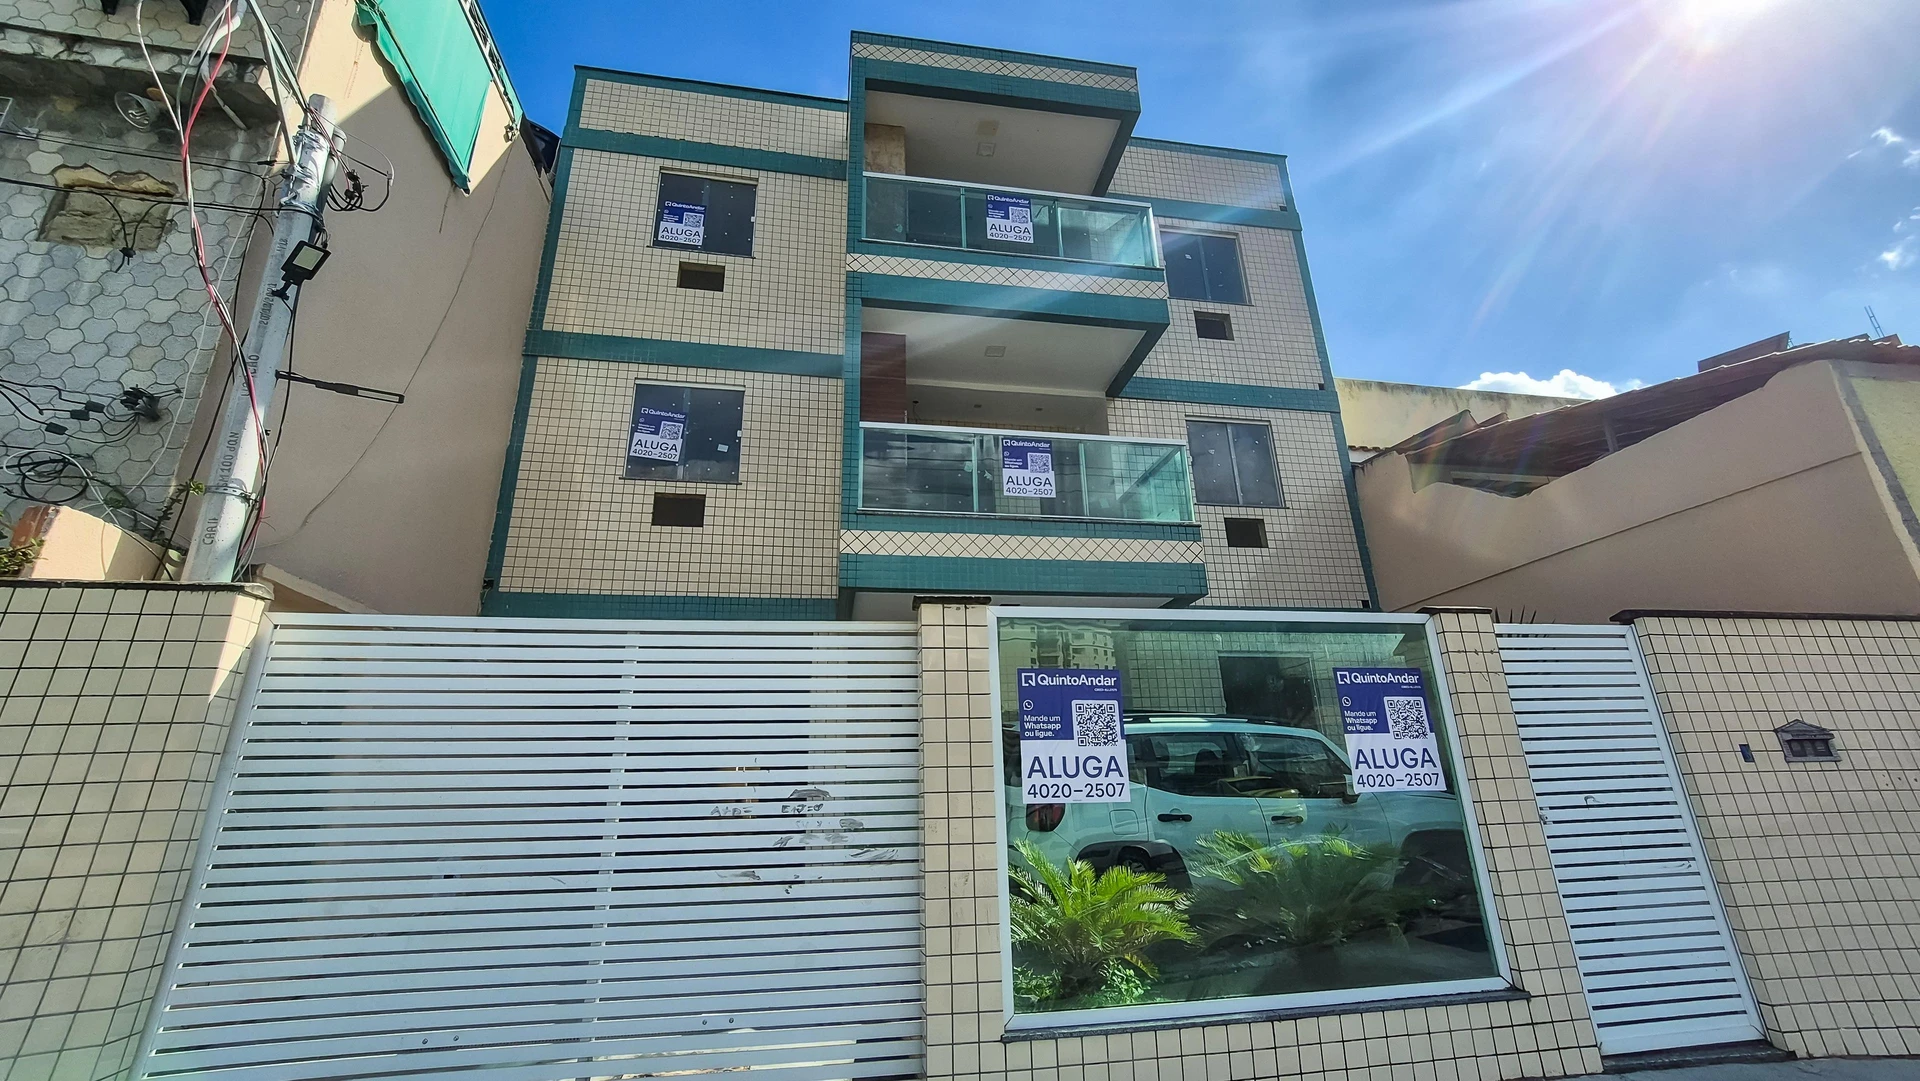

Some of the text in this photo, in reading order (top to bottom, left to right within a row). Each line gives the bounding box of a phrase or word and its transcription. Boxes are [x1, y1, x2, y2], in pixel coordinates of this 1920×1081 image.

[661, 226, 700, 238] ALUGA
[989, 223, 1031, 235] ALUGA
[660, 234, 701, 243] 4020-2507
[990, 232, 1031, 241] 4020-2507
[649, 409, 685, 418] QuintoAndar
[634, 438, 678, 452] ALUGA
[1010, 440, 1050, 448] QuintoAndar
[633, 449, 677, 459] 4020-2507
[1006, 476, 1052, 487] ALUGA
[1006, 487, 1053, 495] 4020-2507
[1037, 674, 1117, 686] QuintoAndar
[1351, 672, 1420, 684] QuintoAndar
[1023, 714, 1047, 722] Mande
[1344, 710, 1365, 718] Mande
[1024, 722, 1062, 730] Whatsapp
[1345, 717, 1378, 725] Whatsapp
[1357, 723, 1374, 733] ligue.
[1035, 729, 1055, 739] ligue.
[1355, 747, 1437, 770] ALUGA
[1027, 755, 1124, 779] ALUGA
[1357, 773, 1439, 788] 4020-2507
[1027, 783, 1125, 799] 4020-2507
